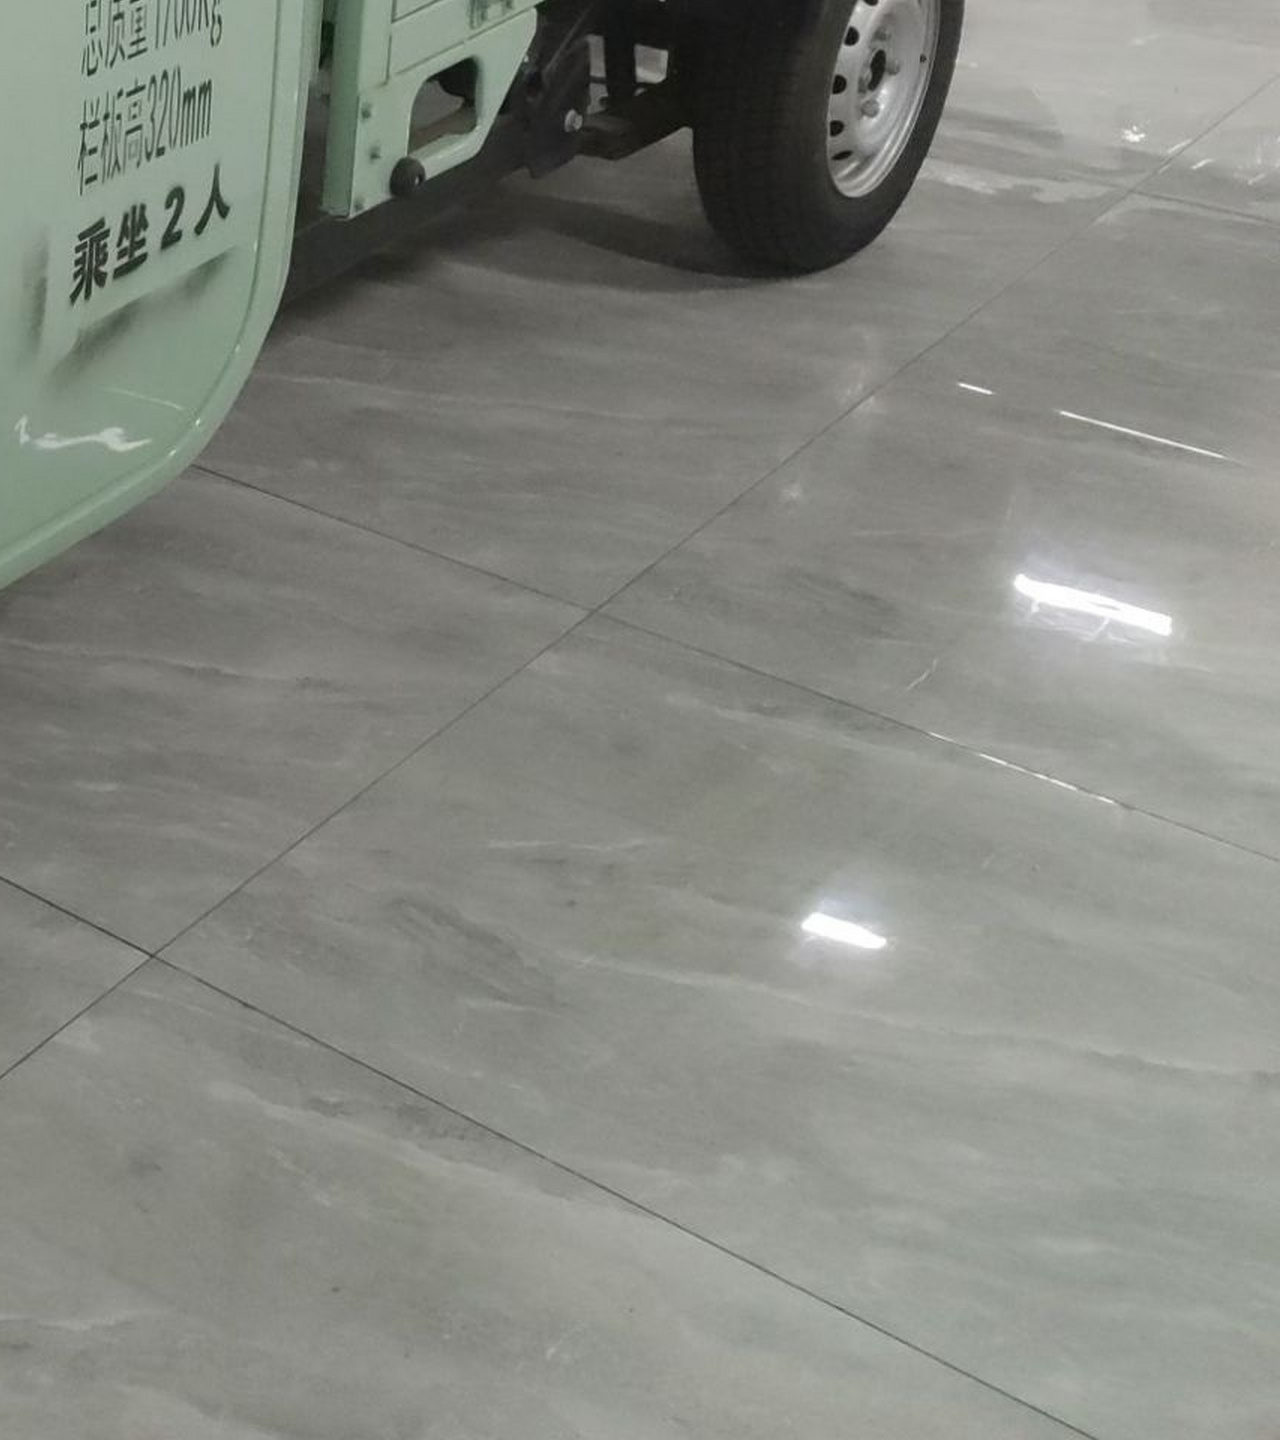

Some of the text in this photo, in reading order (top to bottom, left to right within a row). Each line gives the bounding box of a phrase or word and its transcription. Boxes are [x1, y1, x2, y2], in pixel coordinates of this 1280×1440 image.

[77, 66, 213, 196] 栏板高320mm
[70, 163, 231, 306] 乘坐2人
